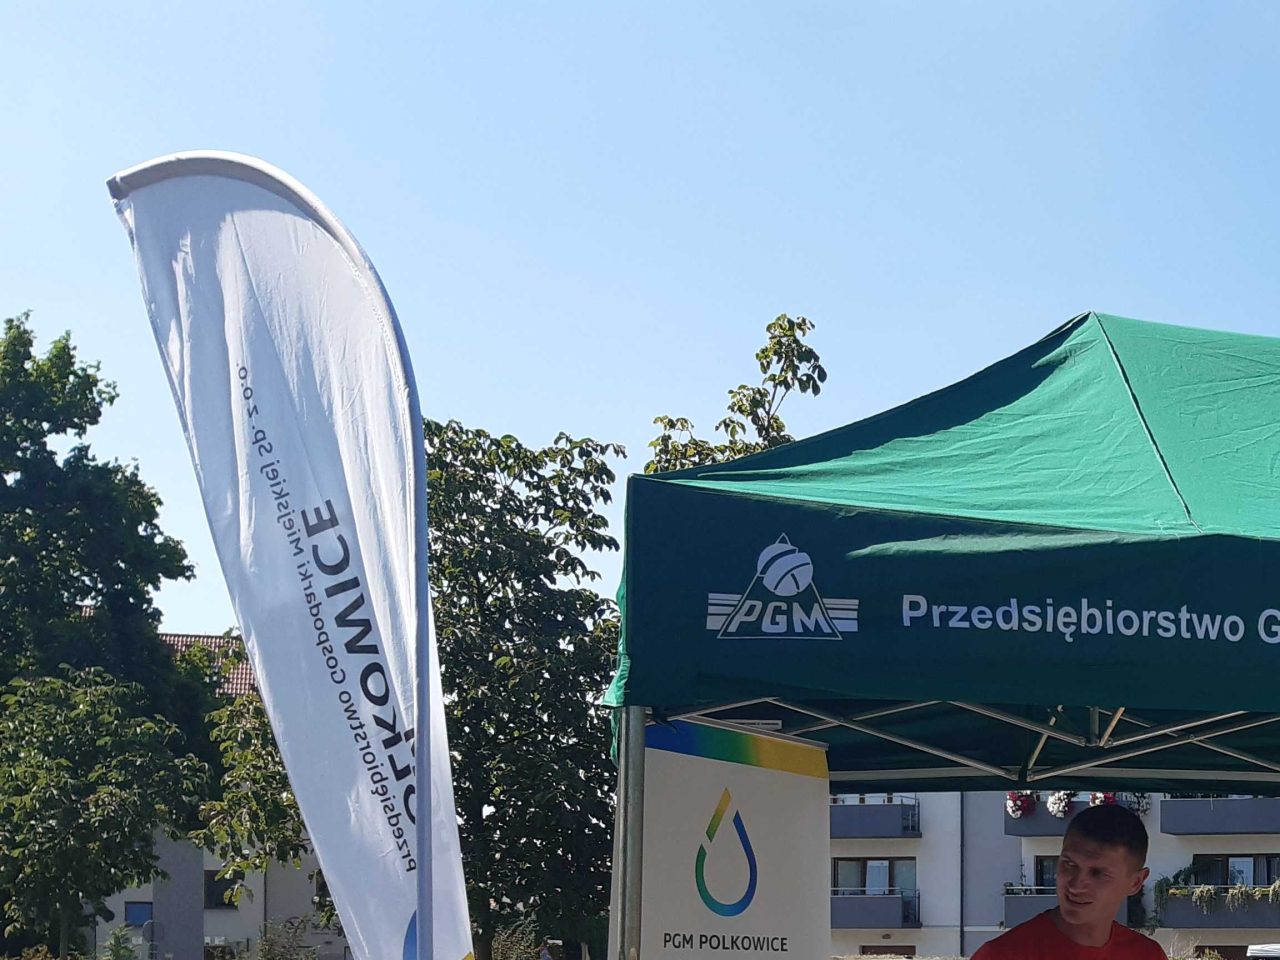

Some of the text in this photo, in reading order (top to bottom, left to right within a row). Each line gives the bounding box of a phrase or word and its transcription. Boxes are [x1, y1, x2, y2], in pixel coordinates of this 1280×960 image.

[726, 600, 833, 633] PGM
[902, 594, 1245, 643] Przedsiębiorstwo
[663, 932, 788, 952] PGM POLKOWICE
